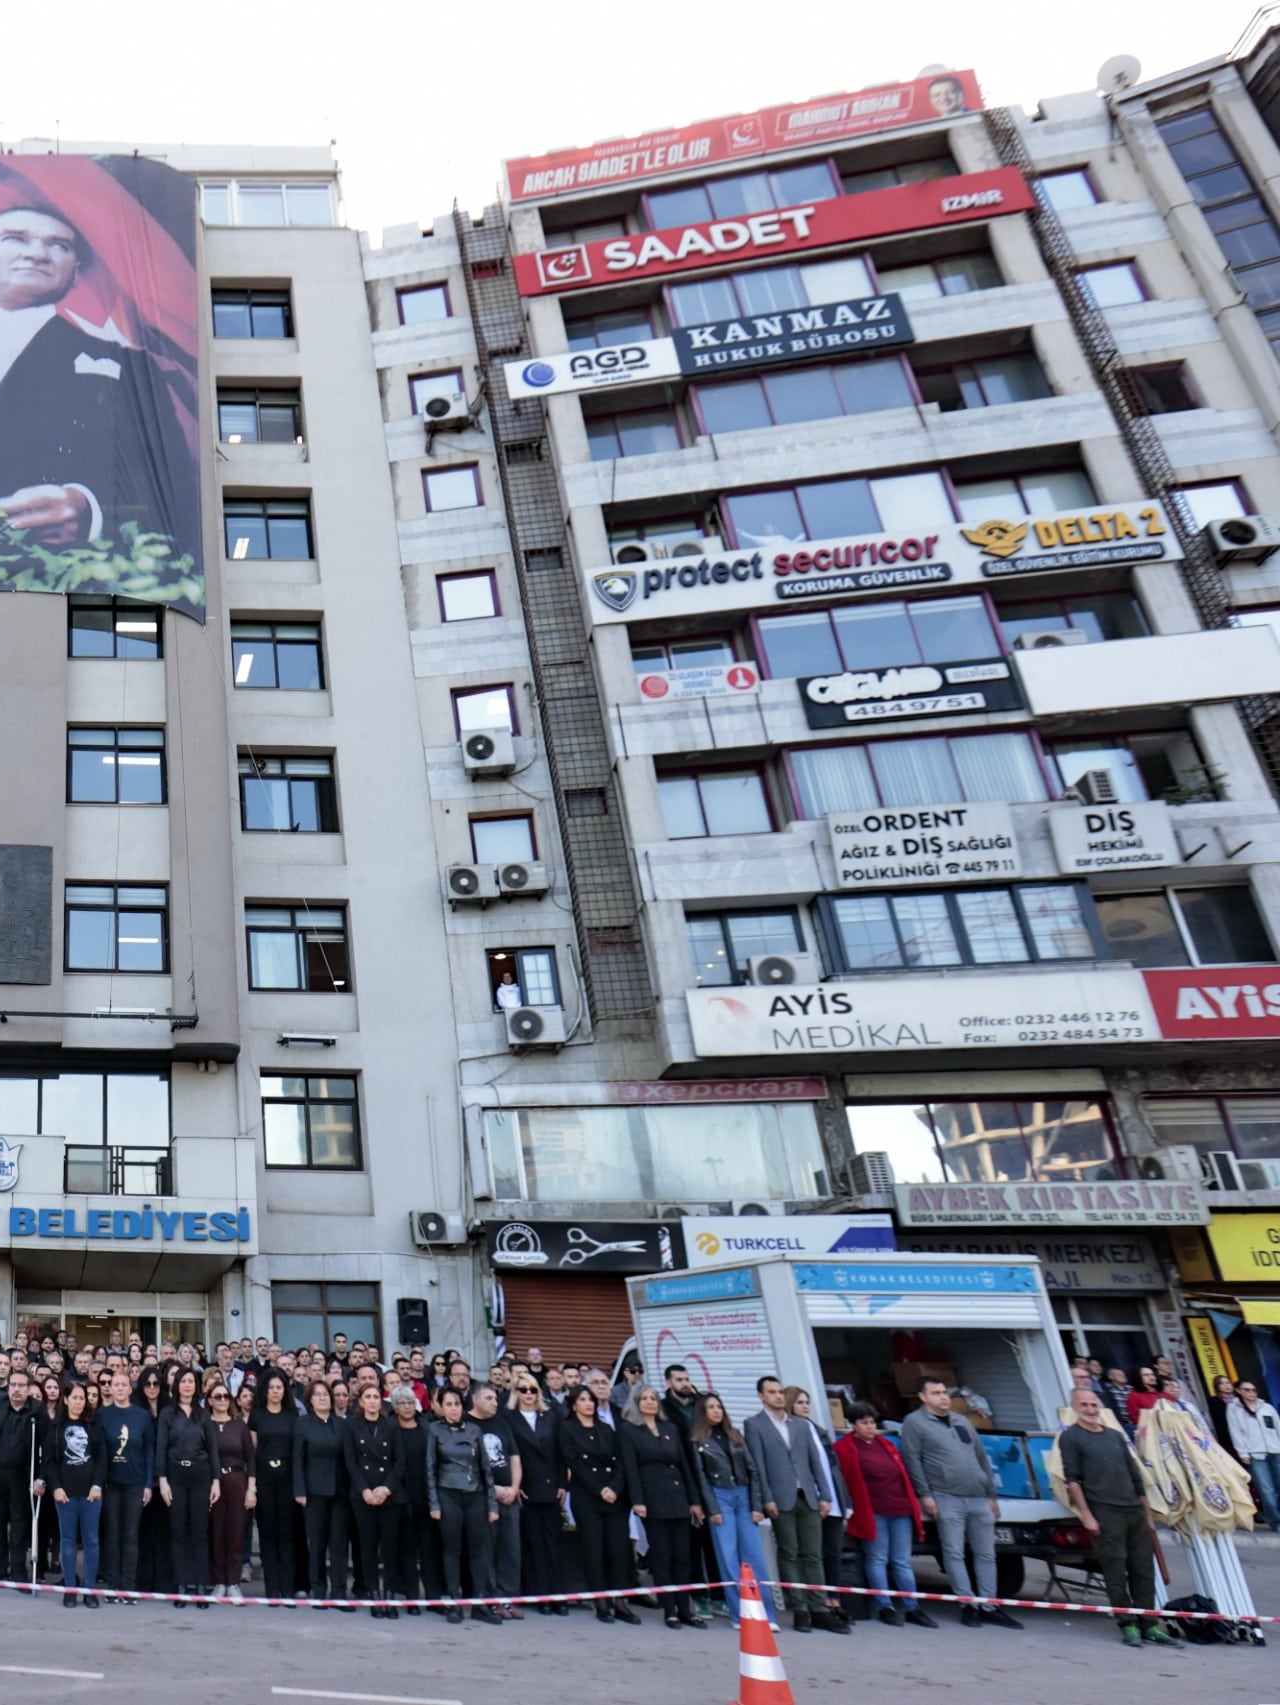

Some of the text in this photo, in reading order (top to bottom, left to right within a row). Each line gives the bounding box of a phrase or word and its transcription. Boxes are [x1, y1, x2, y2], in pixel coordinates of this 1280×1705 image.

[522, 165, 576, 194] ANCAK
[578, 150, 665, 181] SAADET'LE
[667, 137, 712, 163] OLUR
[604, 206, 816, 271] SAADET
[687, 299, 892, 350] KANMAZ
[570, 346, 647, 373] AGD
[694, 324, 897, 369] HUKUK BÜROSU
[1033, 507, 1167, 548] DELTA 2
[643, 551, 764, 599] protect
[783, 563, 947, 596] KORUMA GÜVENLİK
[834, 809, 968, 835] ÖZEL ORDENT
[1085, 809, 1136, 837] DİŞ
[841, 832, 1013, 860] AĞIZ & DİŞ SAĞLIĞI
[1087, 834, 1144, 853] HEKİMİ
[842, 858, 1016, 882] POLİKLİNİĞİ 445 79 11
[769, 988, 854, 1018] AYİS
[773, 1018, 942, 1050] MEDİKAL
[959, 1011, 1140, 1029] Office: 0232 446 12 76
[963, 1027, 1144, 1044] Fax: 0232 484 54 73
[909, 1182, 1200, 1212] AYBEK KIRTASİYE
[10, 1204, 250, 1241] BELEDİYESİ
[724, 1238, 806, 1250] TURKCELL
[1044, 1241, 1146, 1263] MERKEZİ
[850, 1273, 980, 1285] KONAK BELEDİYESİ
[1044, 1270, 1082, 1288] AJI
